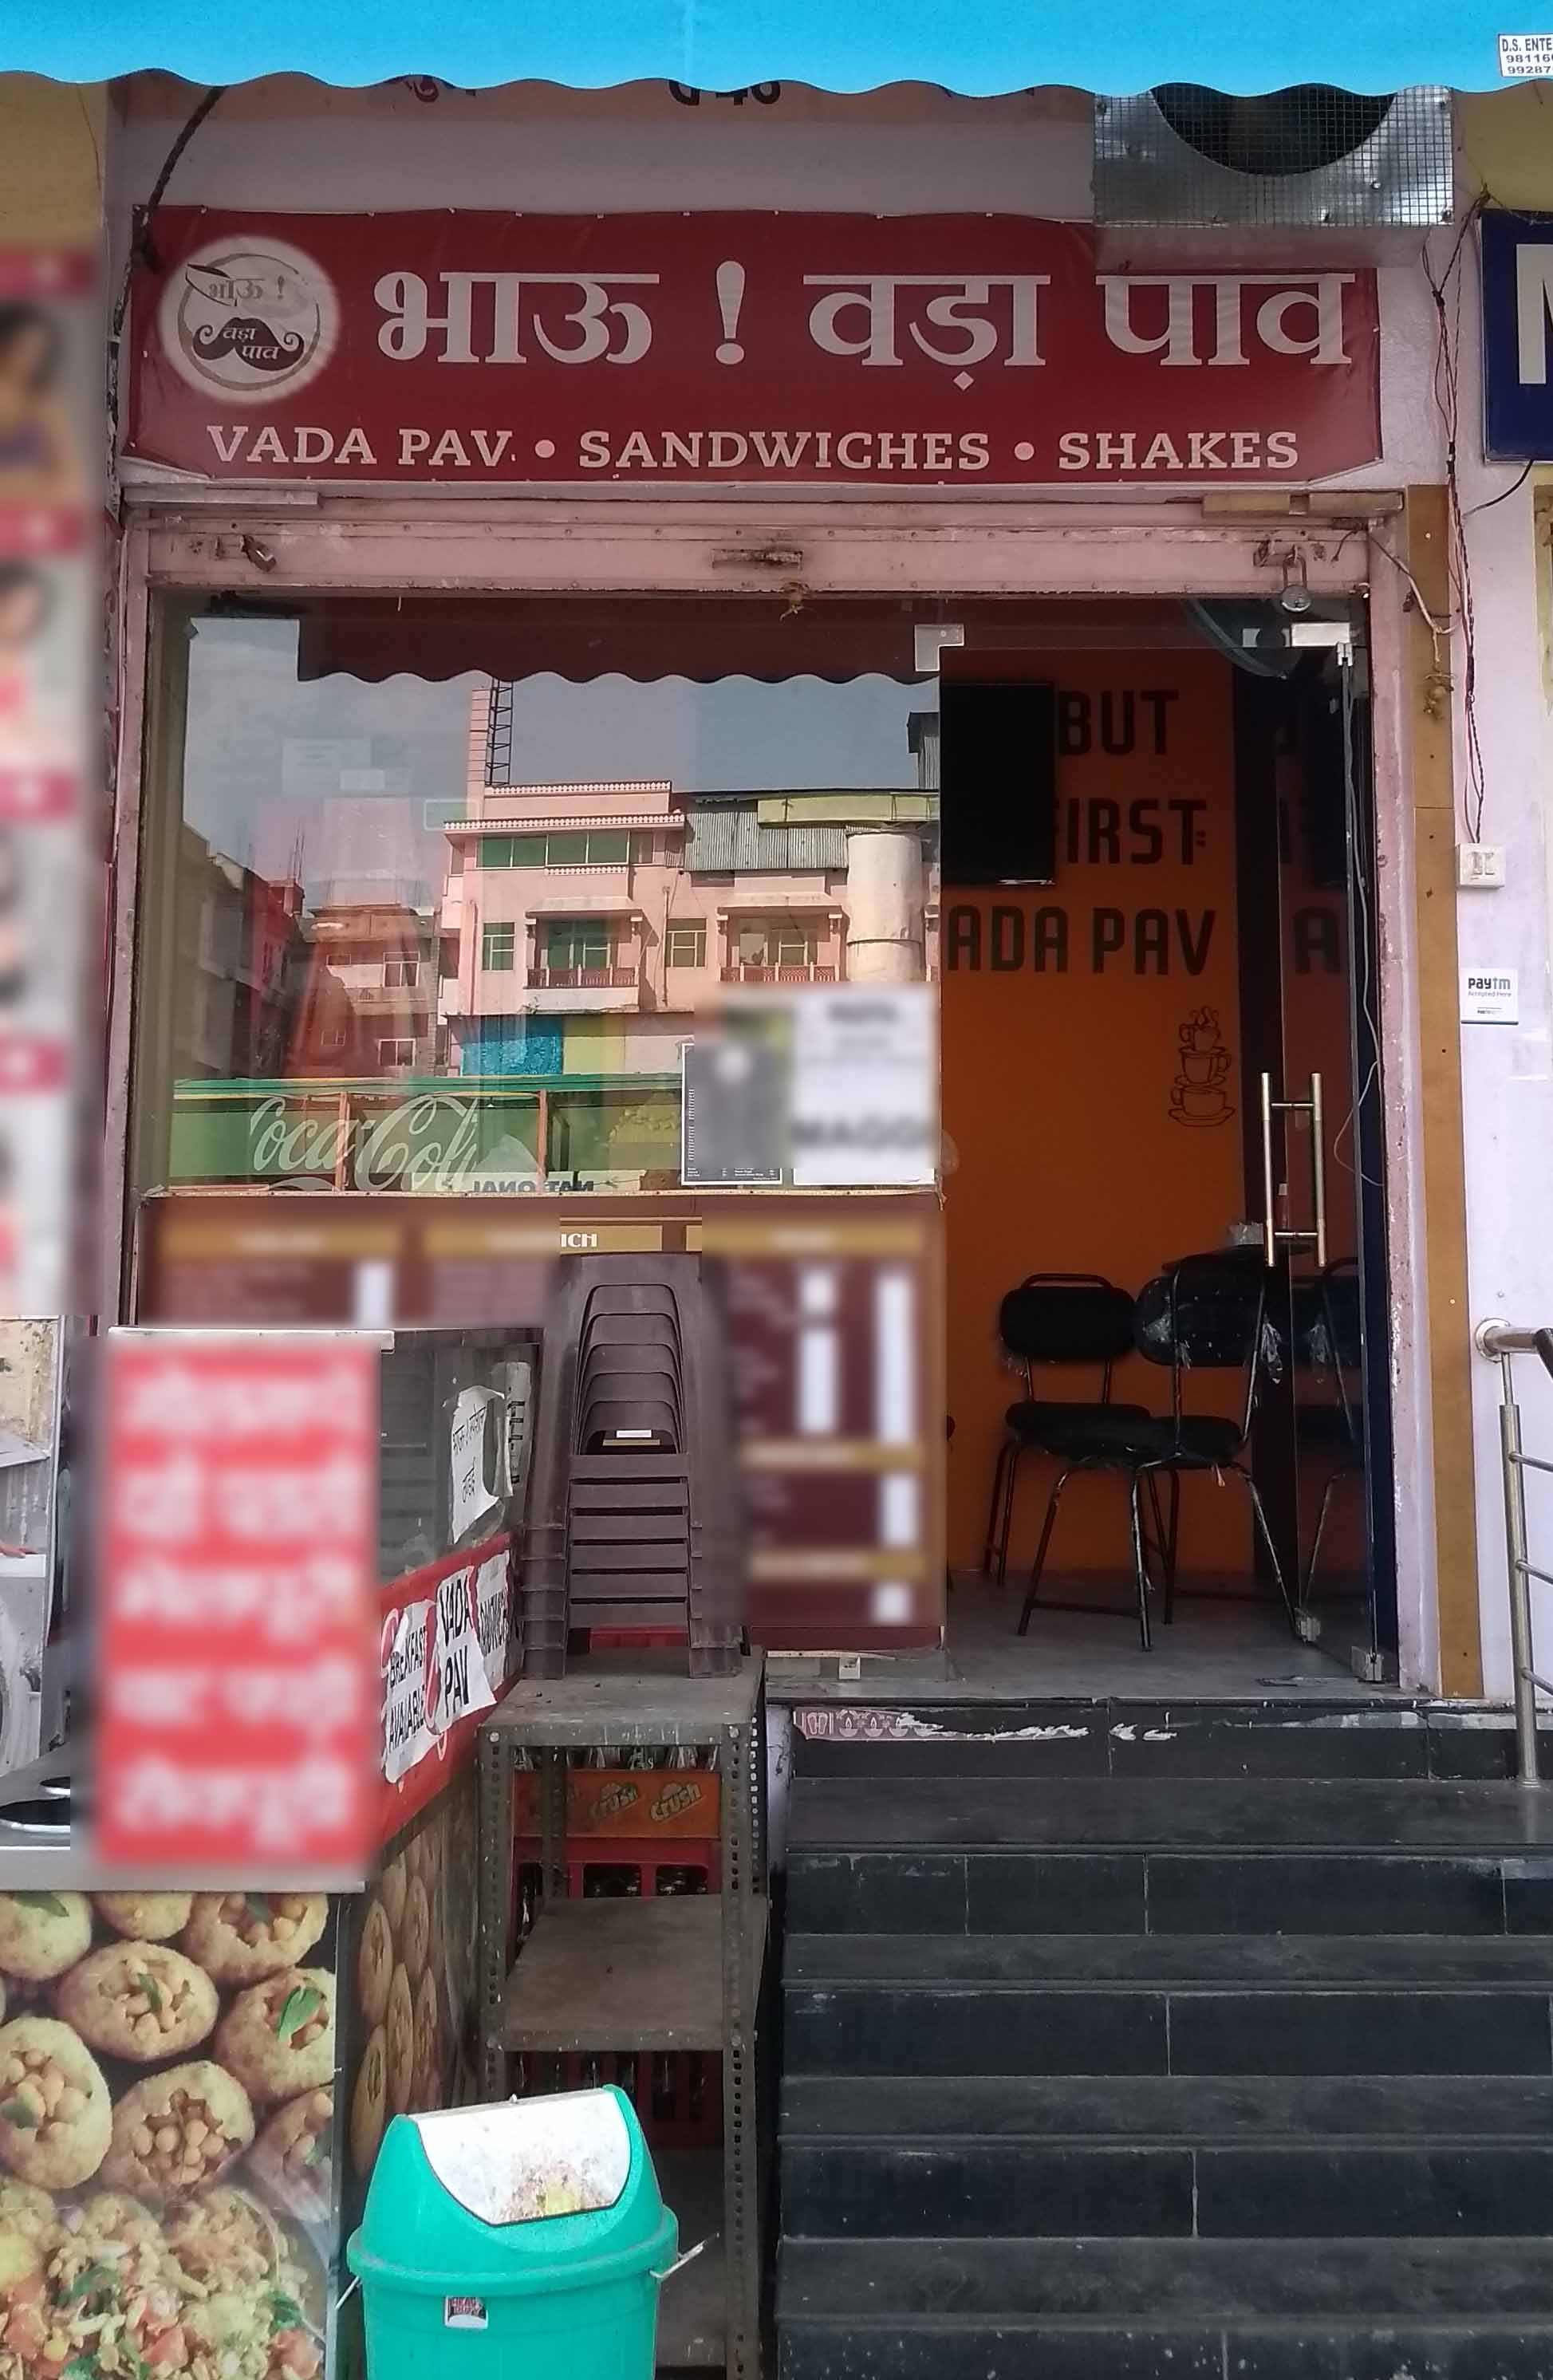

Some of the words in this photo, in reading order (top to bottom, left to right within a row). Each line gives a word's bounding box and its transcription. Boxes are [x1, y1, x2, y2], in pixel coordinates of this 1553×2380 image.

[1502, 38, 1521, 52] D.S.
[1506, 53, 1553, 63] 98116
[241, 345, 280, 361] पाव
[375, 272, 660, 364] भाऊ
[715, 261, 746, 364] !
[803, 275, 1050, 390] वड़ा
[1096, 274, 1356, 365] पाव
[207, 426, 377, 464] VADA
[398, 429, 513, 467] PAV
[579, 431, 991, 470] SANDWICHES
[1058, 431, 1299, 470] SHAKES
[1058, 690, 1180, 756] BUT
[1093, 908, 1216, 975] PAV
[439, 1574, 474, 1646] VADA
[444, 1645, 469, 1718] PAV
